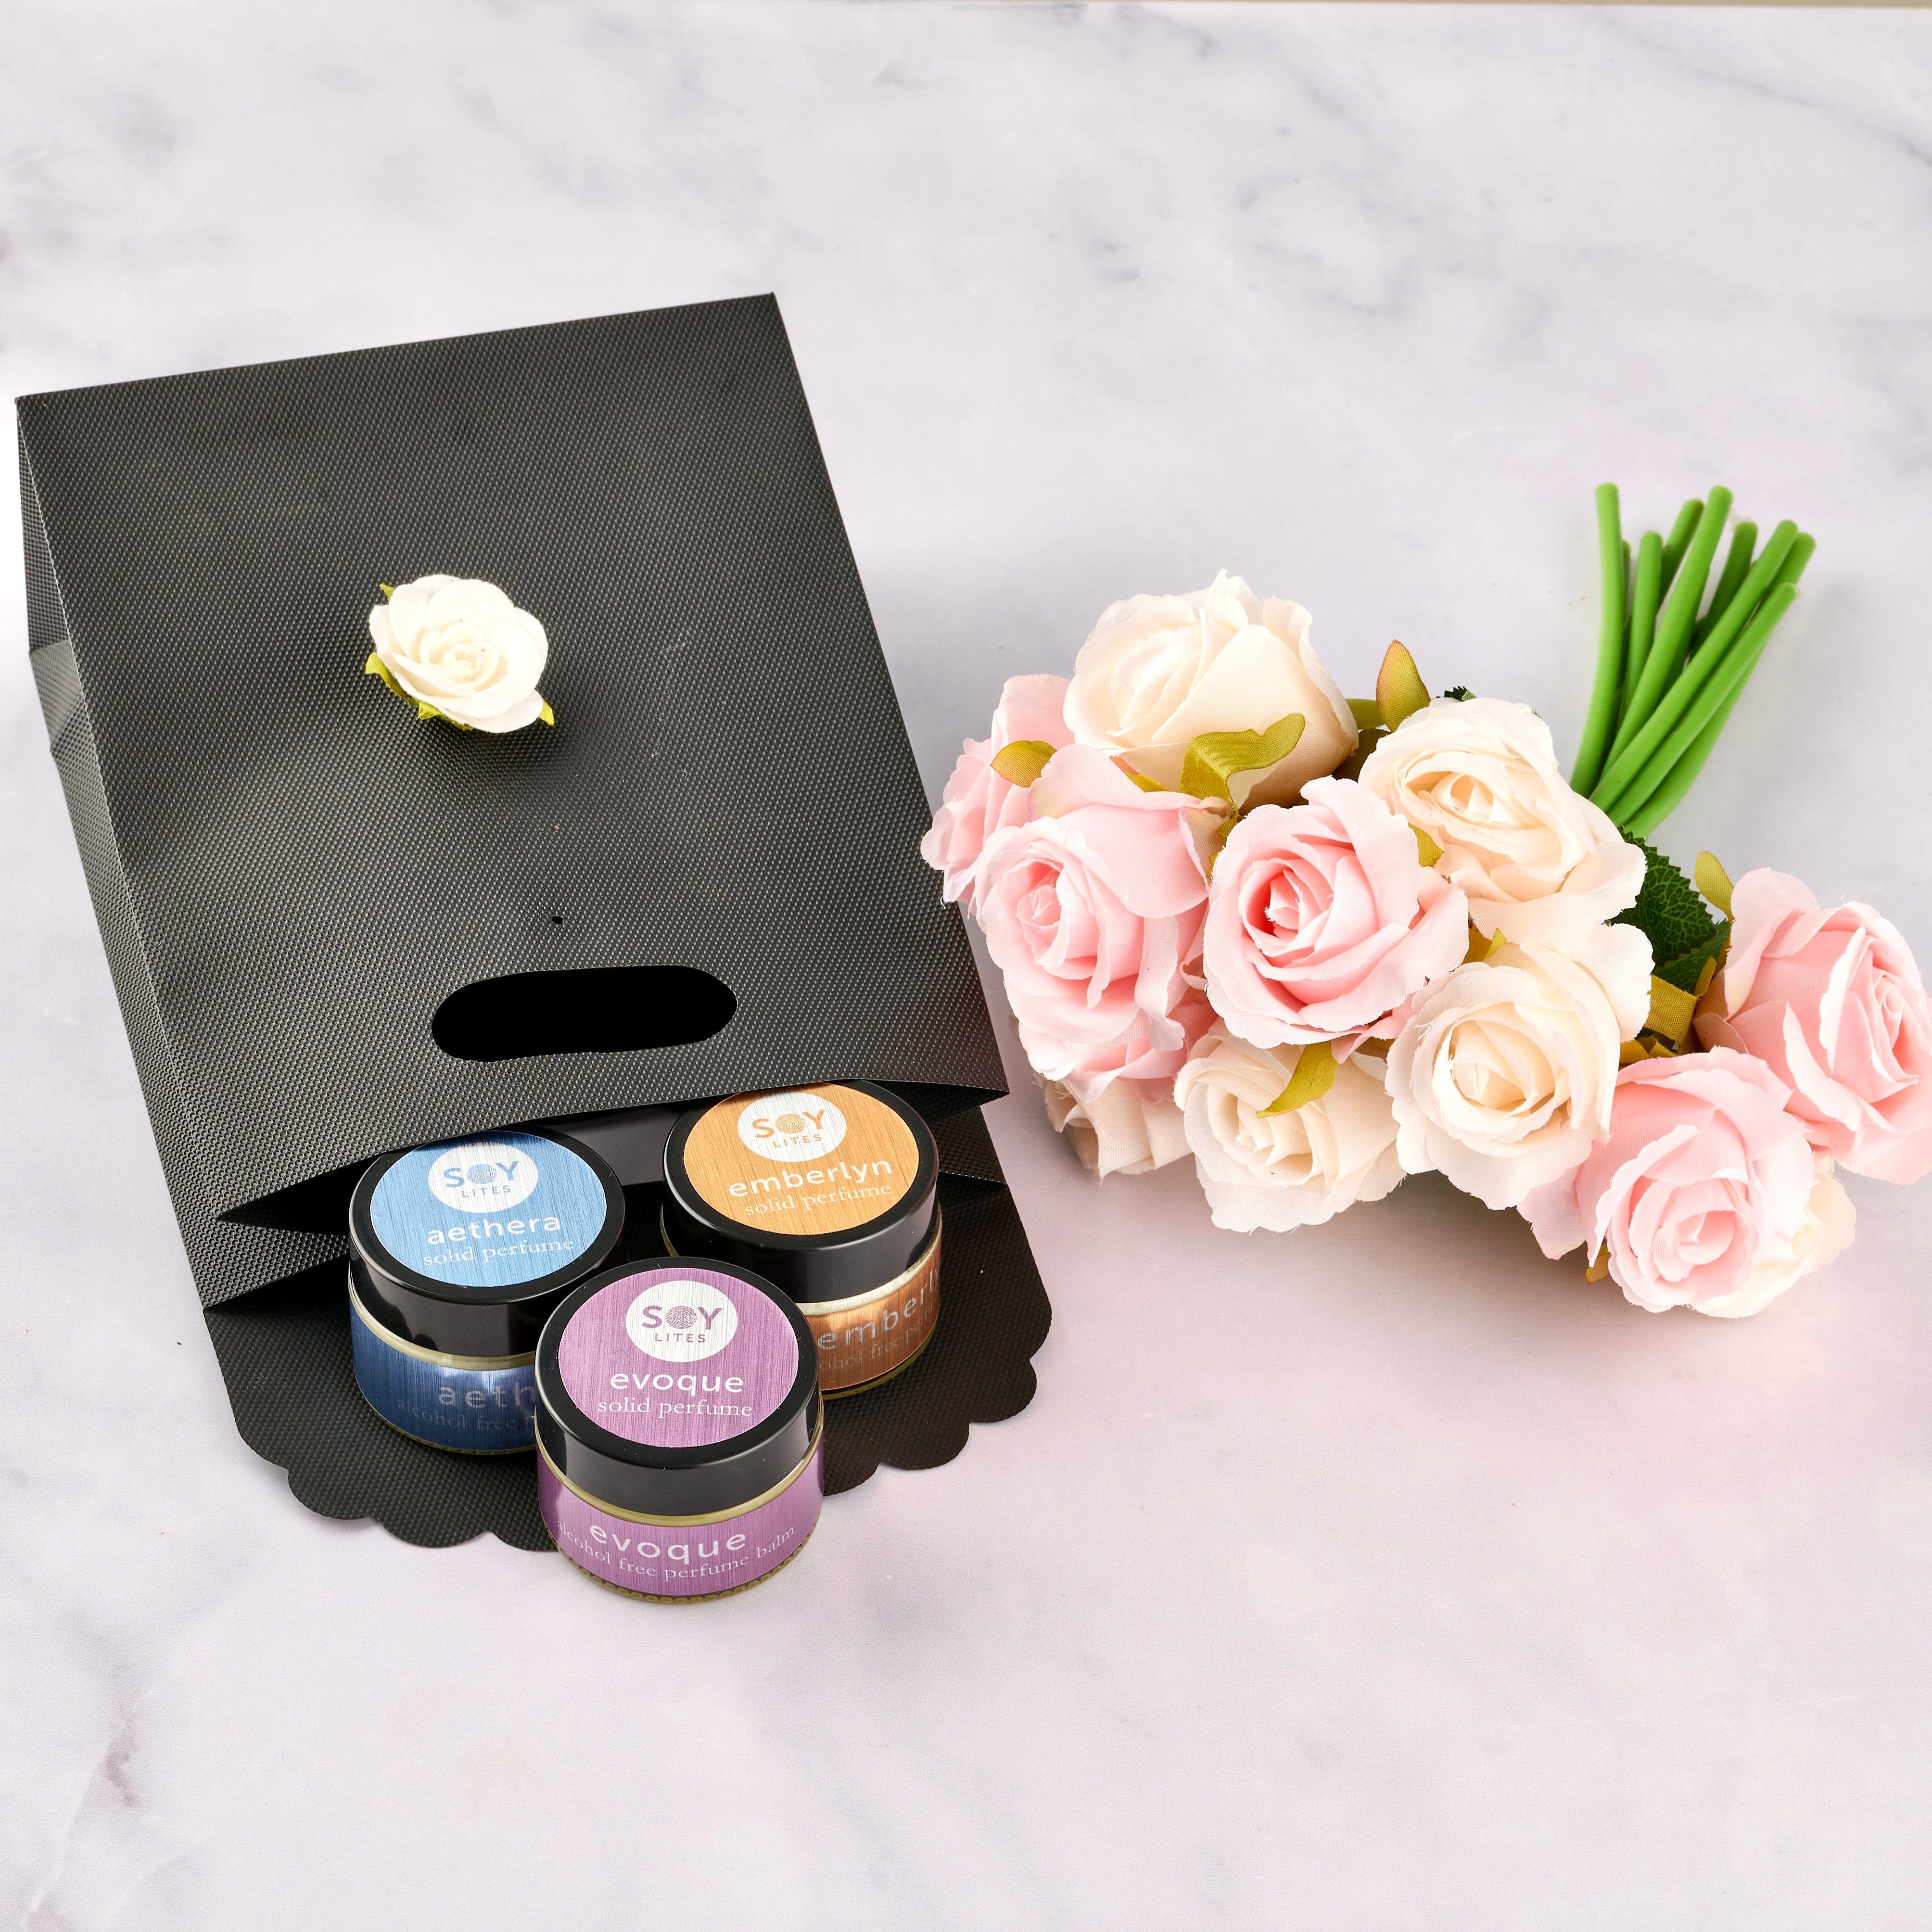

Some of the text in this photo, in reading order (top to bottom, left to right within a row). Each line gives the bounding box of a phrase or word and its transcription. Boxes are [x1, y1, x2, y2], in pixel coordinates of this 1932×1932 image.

[773, 1134, 822, 1148] LITES
[462, 1185, 511, 1198] LITES
[729, 1160, 892, 1197] emberlyn
[746, 1184, 891, 1216] solid perfume
[428, 1215, 560, 1245] aethera
[424, 1239, 573, 1266] solid perfume
[655, 1333, 706, 1343] LITES
[610, 1373, 743, 1397] evoque
[598, 1398, 752, 1418] solid perfume
[557, 1520, 795, 1581] alcohol free perfume balm
[590, 1525, 746, 1564] evoque
